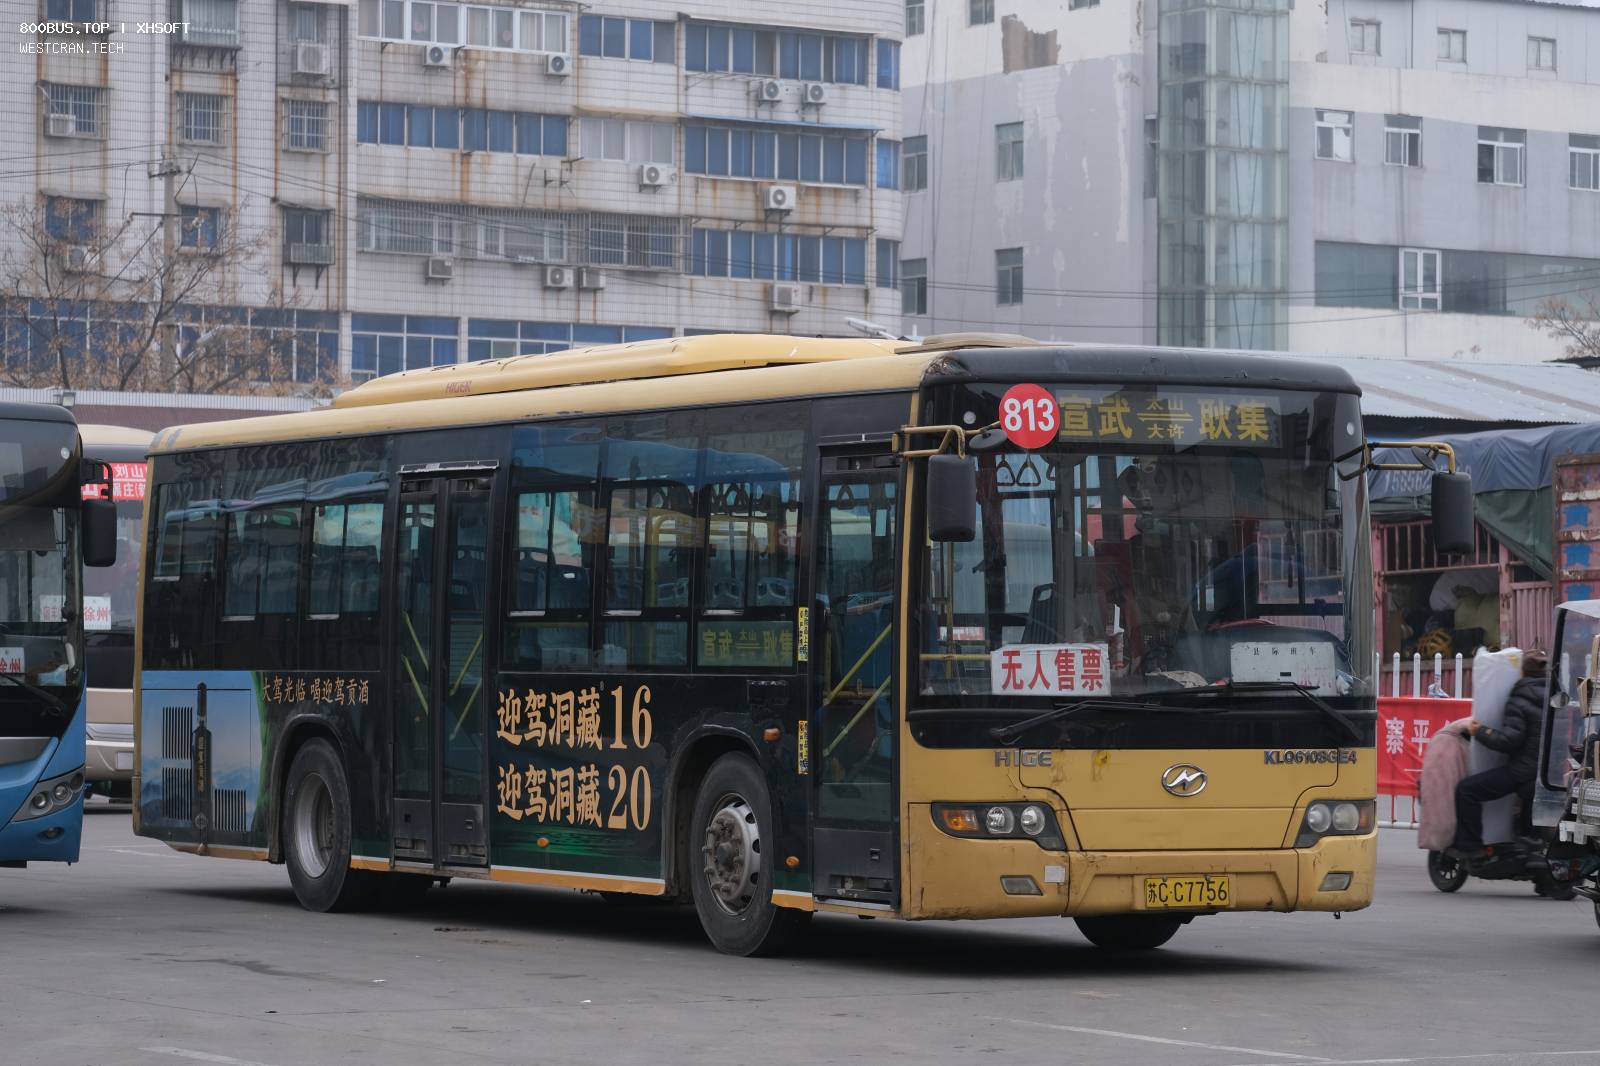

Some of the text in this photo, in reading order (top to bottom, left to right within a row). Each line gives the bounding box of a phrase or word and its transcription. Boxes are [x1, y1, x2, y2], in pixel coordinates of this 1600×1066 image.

[1003, 397, 1055, 432] 813
[1059, 393, 1271, 442] 宣武 耿集
[1147, 423, 1185, 440] 大许
[1001, 648, 1104, 692] 无人售票
[262, 675, 369, 706] 大驾光临 喝迎驾贡酒
